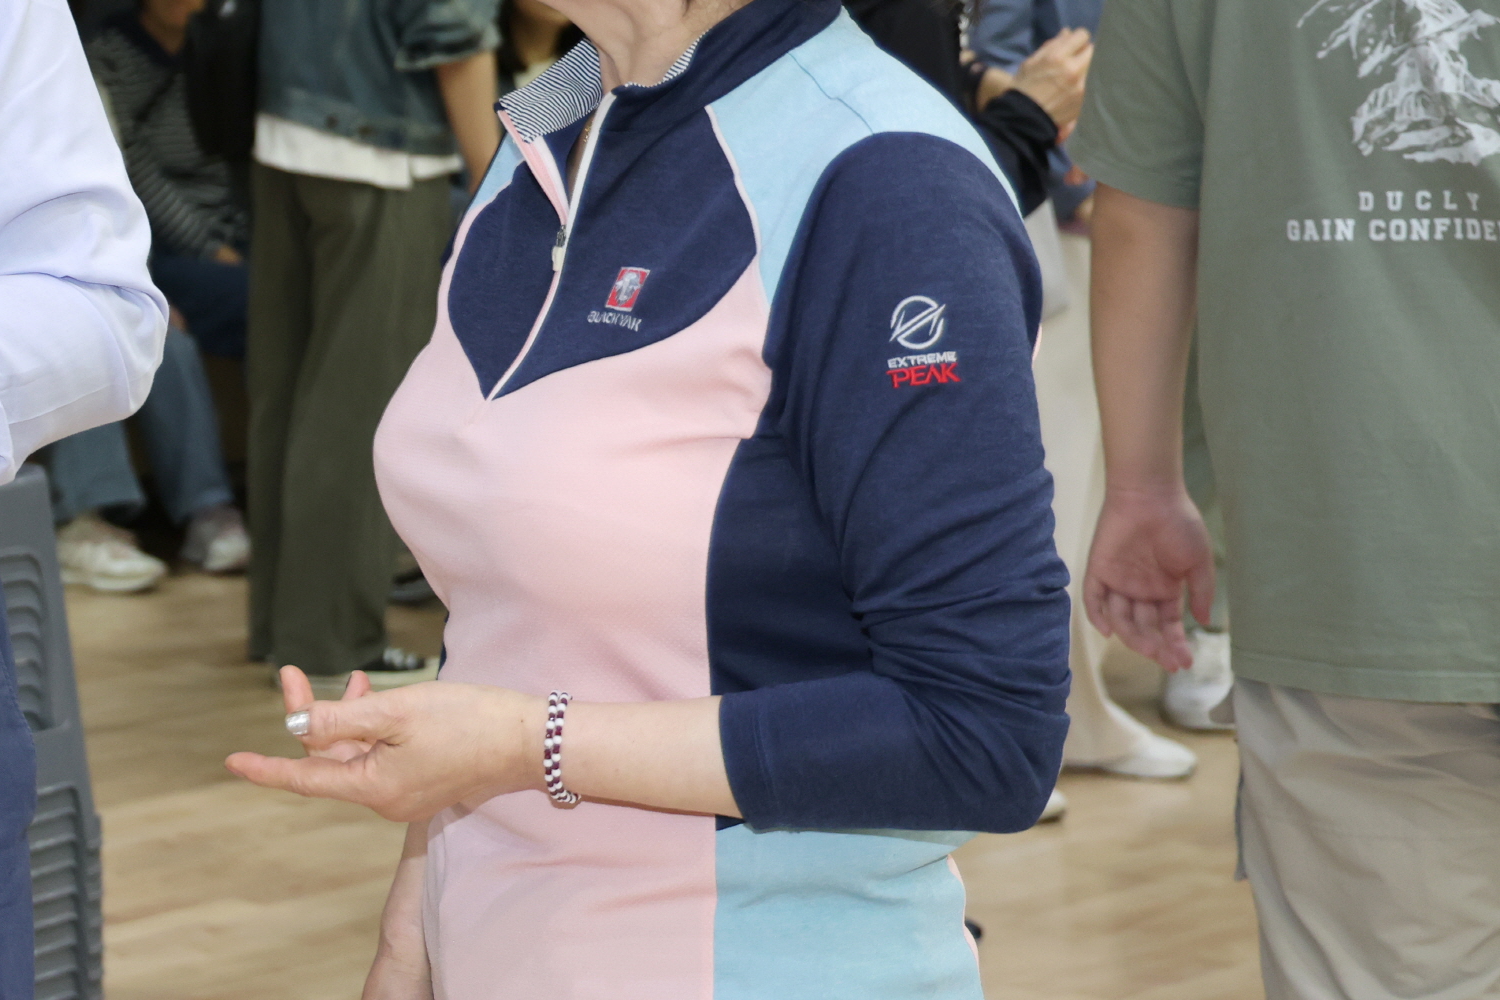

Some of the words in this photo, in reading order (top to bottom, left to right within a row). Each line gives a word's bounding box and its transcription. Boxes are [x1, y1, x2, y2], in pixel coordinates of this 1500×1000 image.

[1358, 189, 1479, 212] DUCLY
[1286, 218, 1356, 242] GAIN
[1368, 217, 1500, 242] CONFIDE
[887, 351, 958, 369] EXTREME
[886, 362, 962, 389] PEAK
